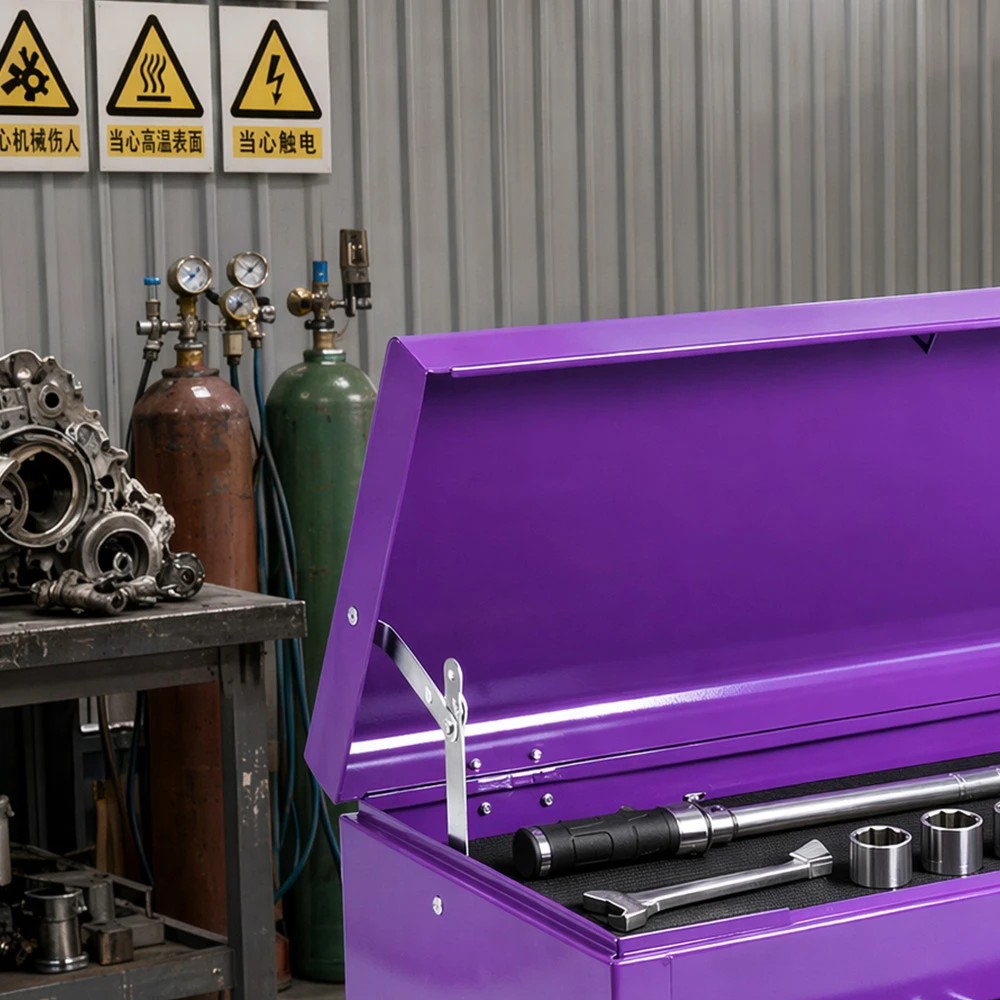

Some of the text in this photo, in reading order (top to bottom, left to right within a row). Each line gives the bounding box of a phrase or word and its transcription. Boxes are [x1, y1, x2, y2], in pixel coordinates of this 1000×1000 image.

[109, 128, 203, 153] 当心高温表面
[239, 129, 317, 154] 当心触电
